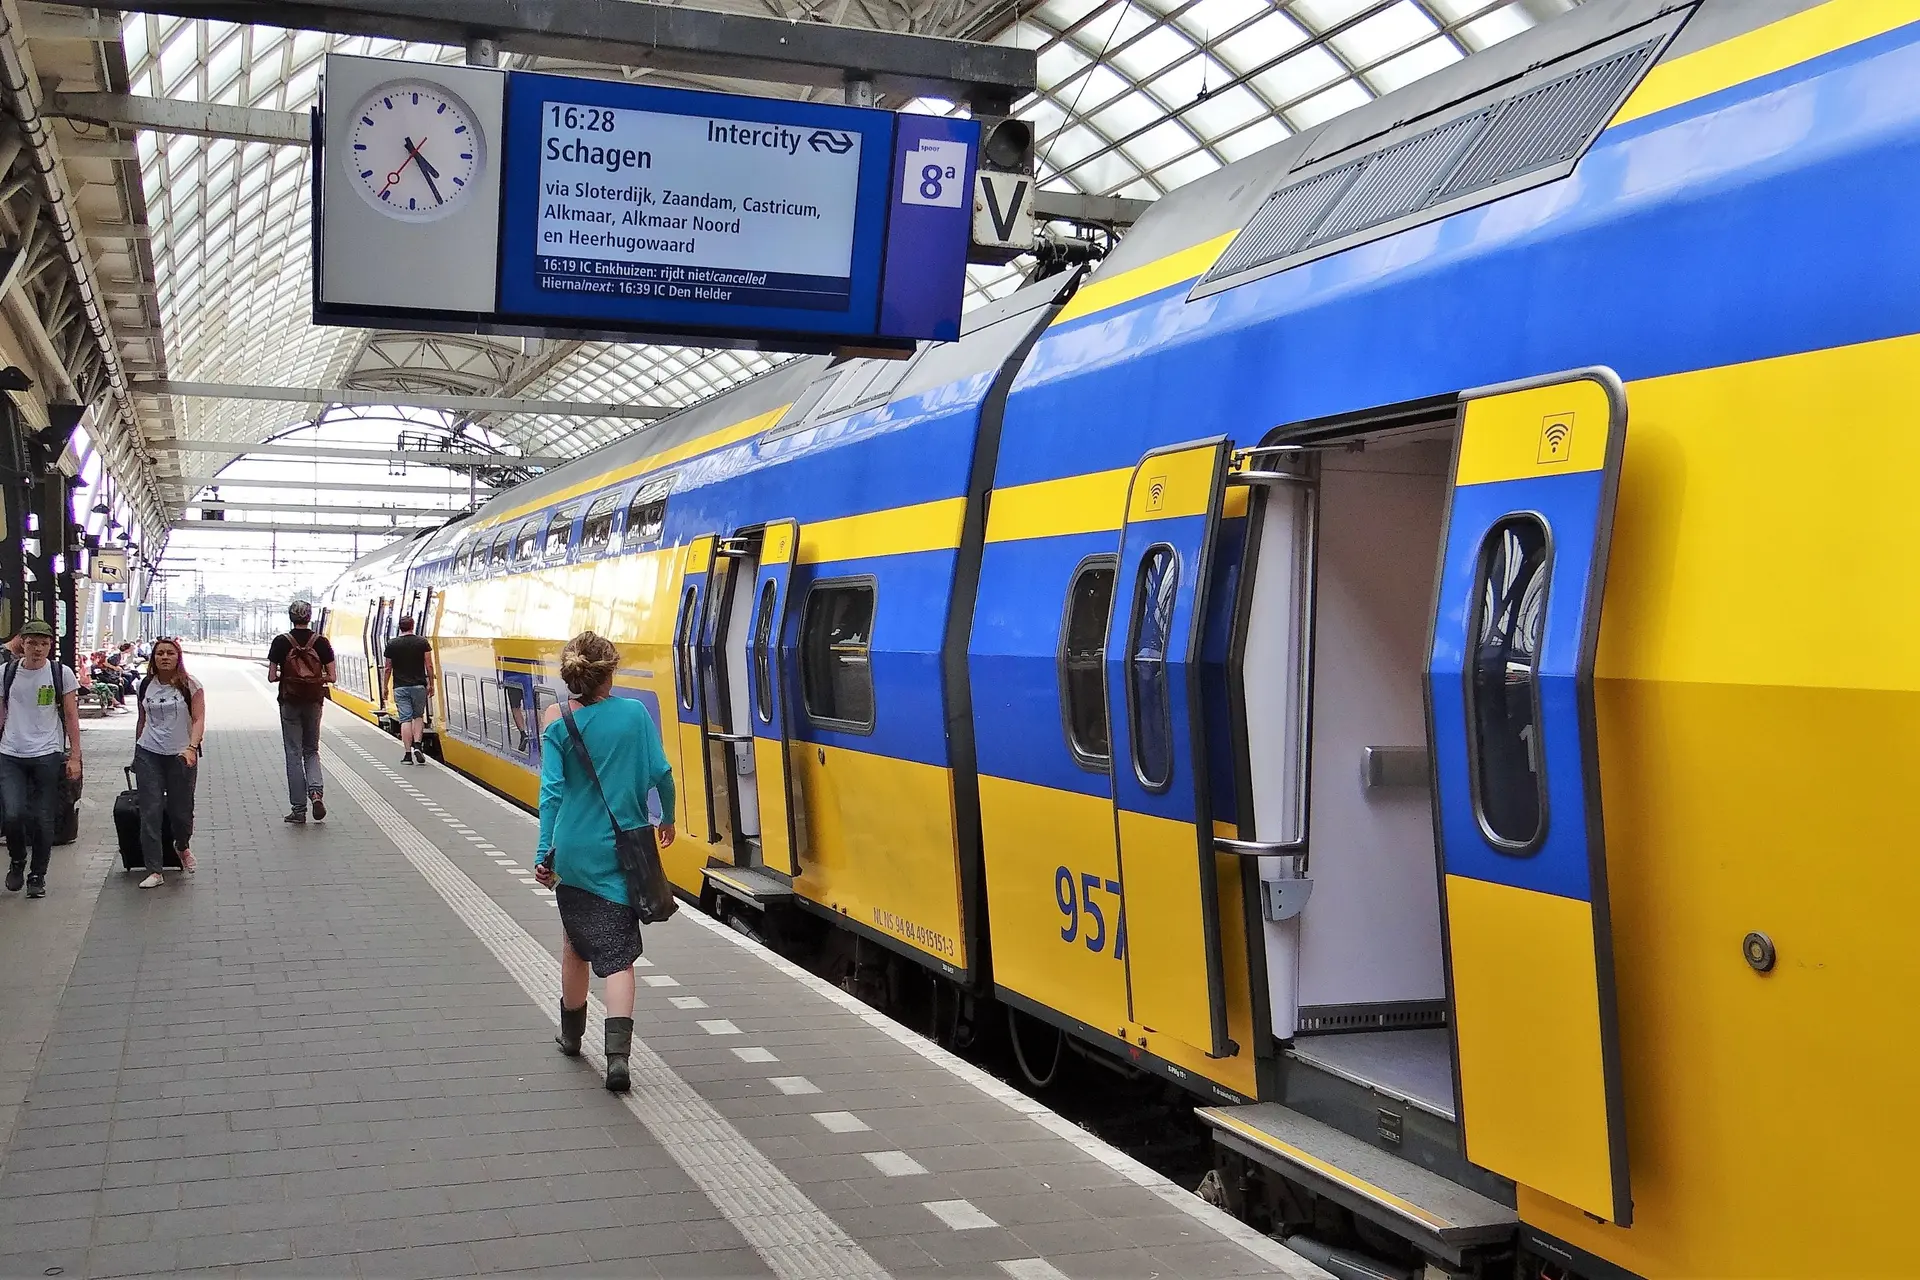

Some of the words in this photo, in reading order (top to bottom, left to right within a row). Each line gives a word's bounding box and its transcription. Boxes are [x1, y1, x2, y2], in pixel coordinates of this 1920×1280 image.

[551, 105, 615, 132] 16:28
[707, 120, 801, 155] Intercity
[921, 144, 940, 152] spoor
[546, 137, 652, 172] Schagen
[920, 164, 956, 200] 8a
[546, 180, 569, 197] via
[575, 182, 656, 206] Sloterdijk,
[662, 190, 737, 213] Zaandam,
[743, 197, 821, 219] Castricum,
[980, 176, 1028, 241] V
[544, 204, 616, 226] Alkmaar,
[622, 210, 687, 230] Alkmaar
[693, 216, 740, 234] Noord
[544, 230, 563, 243] en
[569, 229, 695, 253] Heerhugowaard
[543, 258, 576, 272] 16:19
[580, 261, 592, 273] IC
[595, 262, 657, 278] Enkhuizen:
[661, 266, 684, 282] rijdt
[688, 268, 767, 286] niet/cancelled
[542, 276, 615, 293] Hierna/next:
[619, 282, 650, 295] 16:39
[654, 284, 665, 296] IC
[669, 285, 691, 298] Den
[694, 286, 732, 300] Helder
[896, 915, 904, 935] 94
[905, 920, 915, 940] 84
